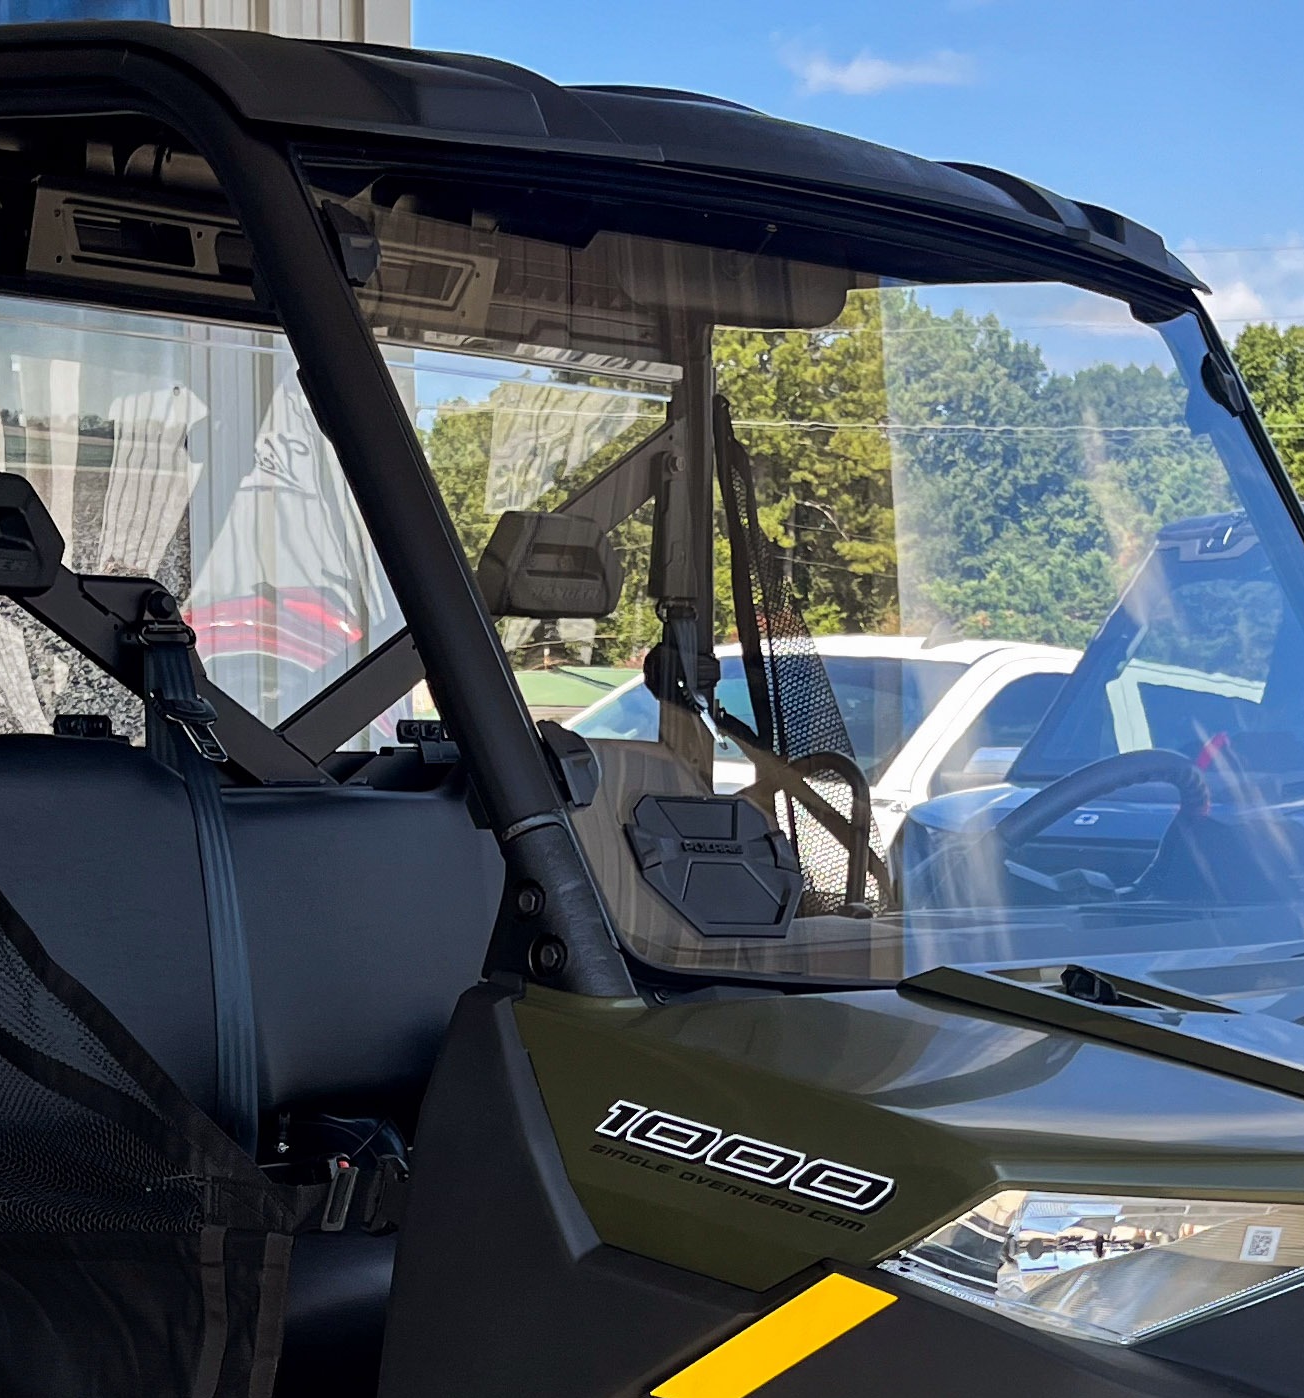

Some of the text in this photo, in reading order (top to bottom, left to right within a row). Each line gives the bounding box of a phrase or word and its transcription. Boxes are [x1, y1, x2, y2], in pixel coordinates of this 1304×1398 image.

[588, 1143, 868, 1233] SINGLE OVERHEAD CAM
[595, 1099, 897, 1215] 1000
